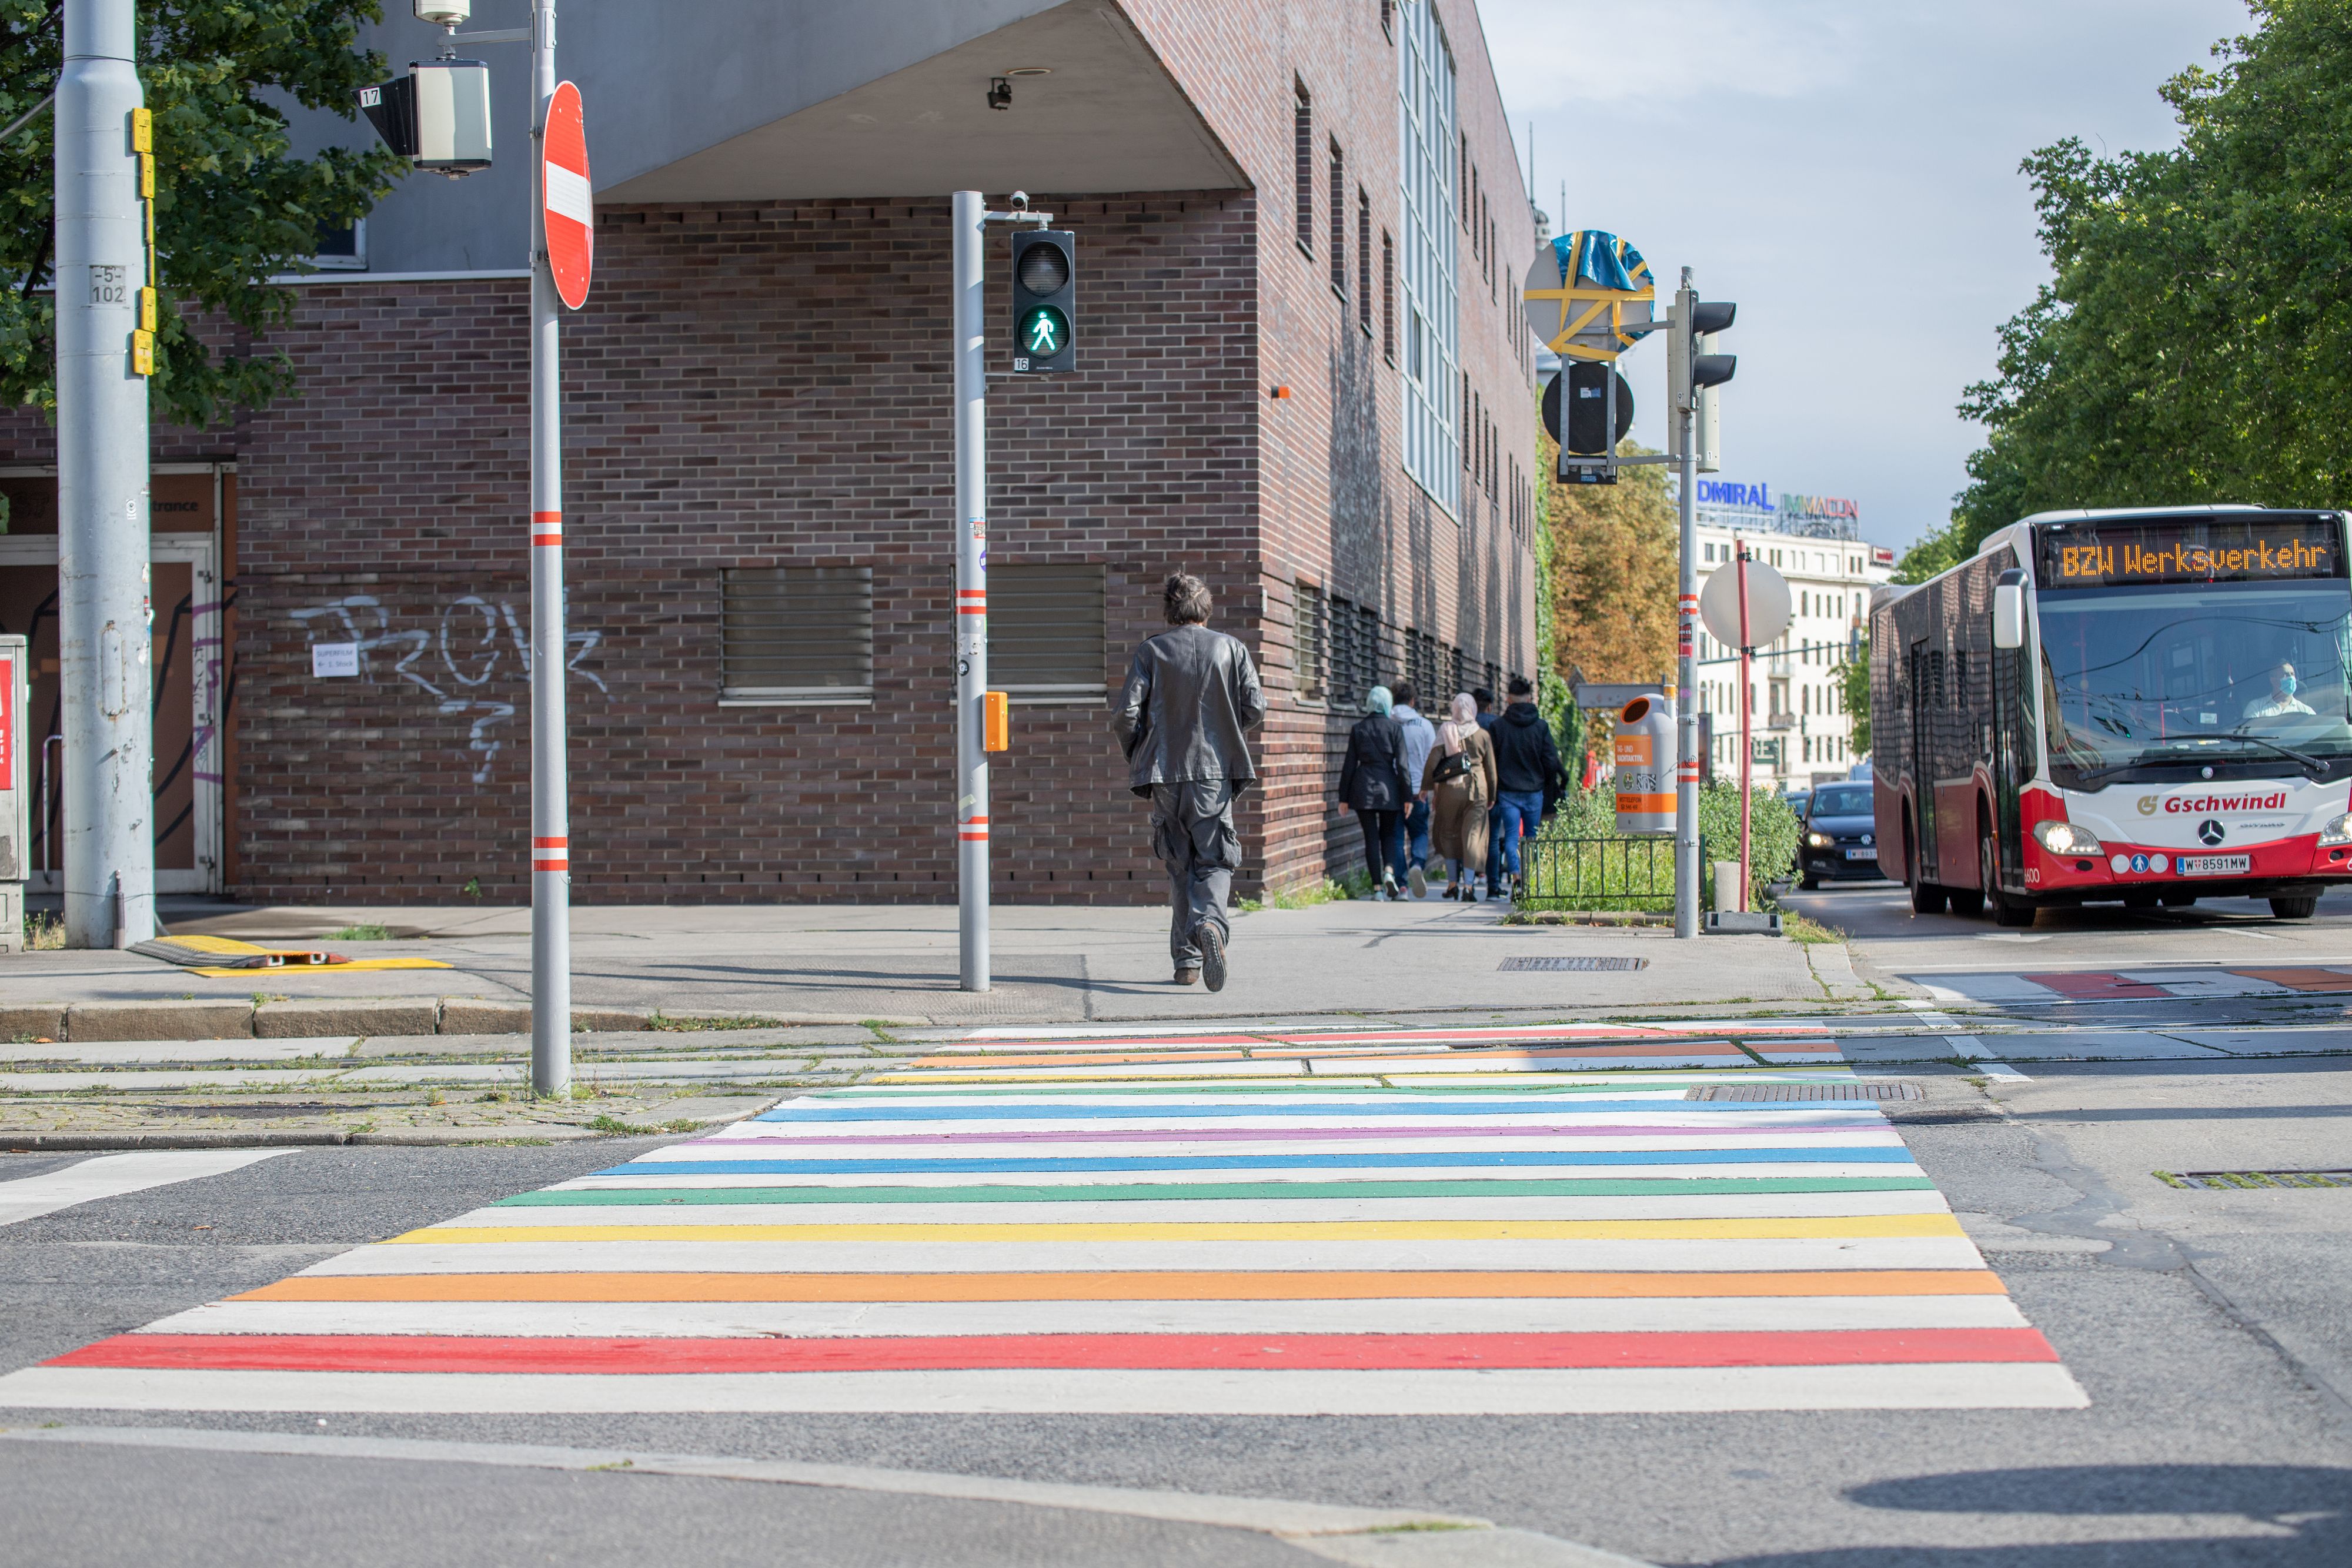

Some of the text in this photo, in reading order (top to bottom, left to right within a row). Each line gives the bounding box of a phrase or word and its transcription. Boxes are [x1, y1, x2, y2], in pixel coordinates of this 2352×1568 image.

[363, 89, 378, 105] 17
[92, 286, 123, 302] 102
[1017, 359, 1027, 369] 16
[1698, 480, 1774, 510] DMIRAL
[152, 500, 198, 511] trance
[2063, 538, 2326, 577] BZW Werksverkehr
[2164, 793, 2286, 813] Gschwindl
[2186, 859, 2194, 871] W
